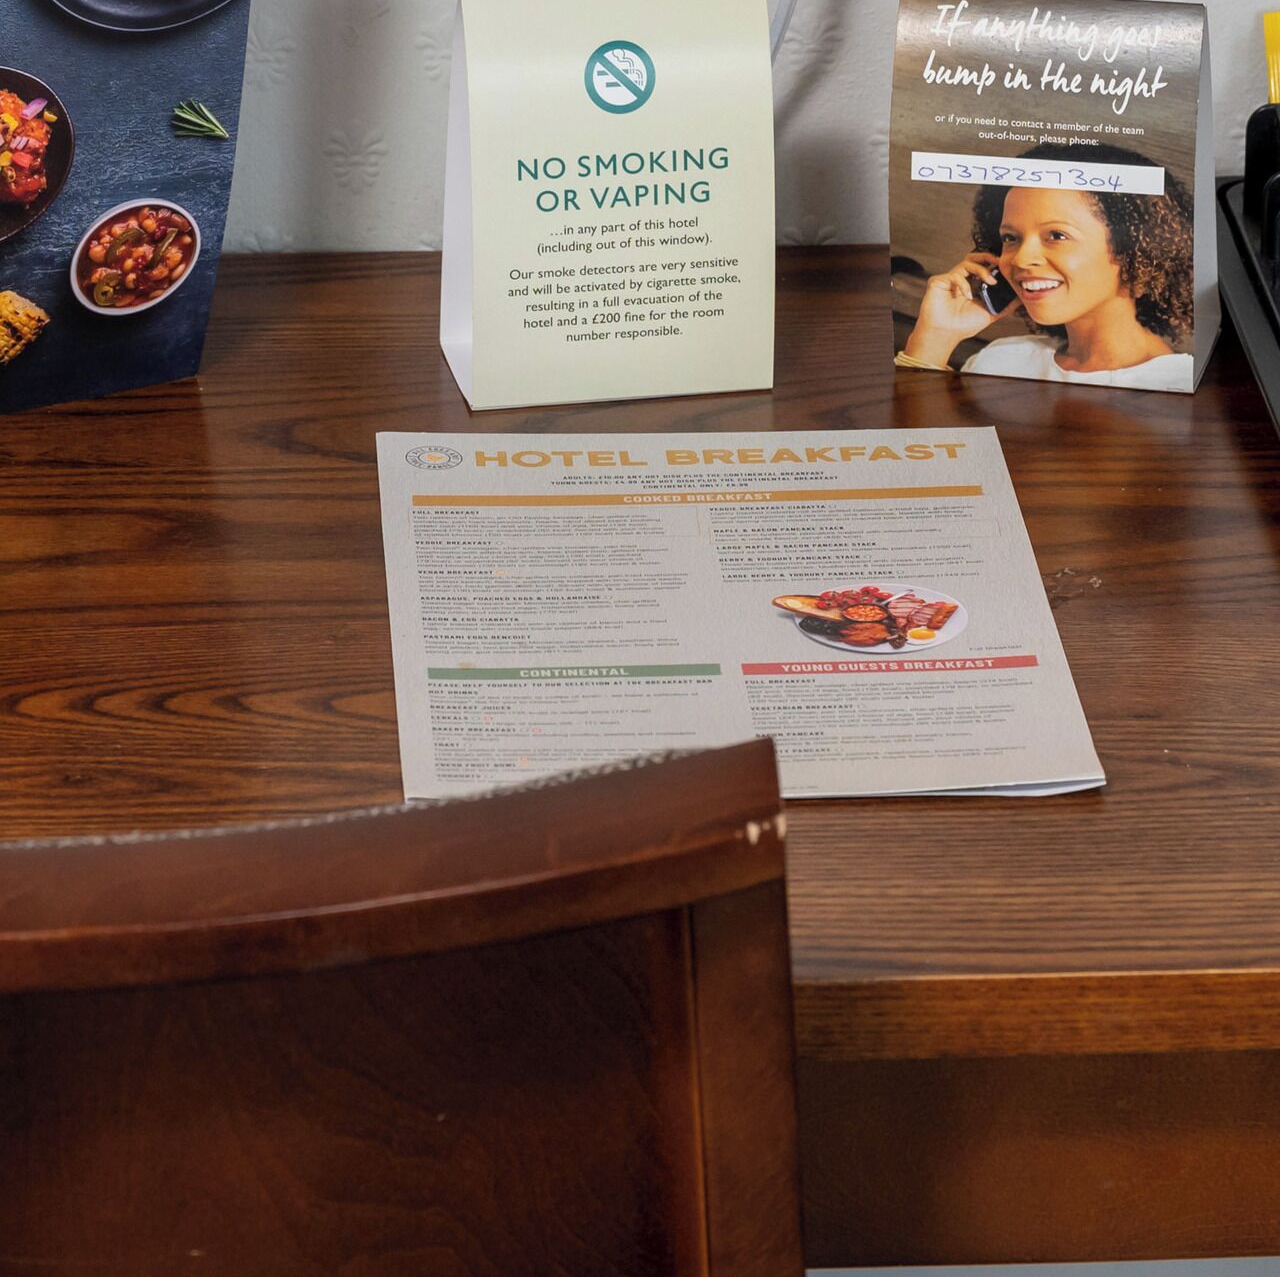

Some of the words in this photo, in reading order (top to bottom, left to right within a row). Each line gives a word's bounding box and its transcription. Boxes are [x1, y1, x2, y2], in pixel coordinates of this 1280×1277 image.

[930, 0, 971, 46] If
[973, 7, 1098, 61] anything
[923, 49, 996, 95] bump
[1004, 63, 1032, 91] in
[1040, 59, 1082, 93] the
[1090, 66, 1168, 115] night
[947, 113, 954, 122] if
[955, 116, 972, 126] you
[974, 116, 996, 126] need
[998, 118, 1008, 126] to
[1010, 120, 1044, 129] contact
[1053, 122, 1091, 131] member
[1092, 123, 1103, 132] of
[1104, 124, 1119, 133] the
[1122, 127, 1144, 135] team
[1039, 133, 1067, 144] please
[517, 157, 565, 181] NO
[578, 147, 728, 177] SMOKING
[536, 189, 580, 212] OR
[590, 181, 710, 208] VAPING
[577, 226, 597, 236] any
[601, 223, 625, 235] part
[628, 219, 641, 231] of
[644, 219, 664, 230] this
[668, 216, 698, 228] hotel
[537, 241, 592, 255] (including
[596, 241, 615, 250] out
[619, 237, 632, 248] of
[635, 237, 655, 247] this
[509, 269, 534, 280] Our
[538, 266, 575, 278] smoke
[579, 265, 635, 275] detectors
[638, 264, 657, 272] are
[661, 262, 686, 272] very
[690, 257, 738, 269] sensitive
[508, 285, 528, 297] and
[532, 284, 552, 295] will
[556, 283, 570, 294] be
[574, 279, 625, 292] activated
[629, 279, 642, 291] by
[646, 277, 696, 290] cigarette
[526, 300, 575, 312] resulting
[602, 296, 619, 307] full
[623, 295, 684, 306] evacuation
[688, 290, 700, 302] of
[704, 290, 722, 301] the
[523, 316, 553, 328] hotel
[557, 315, 577, 326] and
[581, 317, 587, 325] a
[592, 312, 620, 324] £200
[624, 311, 645, 322] fine
[649, 310, 666, 320] for
[670, 309, 688, 319] the
[692, 308, 724, 317] room
[566, 330, 610, 341] number
[614, 325, 684, 340] responsible.
[476, 450, 649, 468] HOTEL
[666, 443, 967, 466] BREAKFAST
[623, 495, 681, 503] COOKED
[686, 493, 772, 501] BREAKFAST
[519, 667, 628, 677] CONTINENTAL
[781, 663, 833, 672] YOUNG
[838, 662, 898, 671] GUESTS
[903, 659, 994, 669] BREAKFAST
